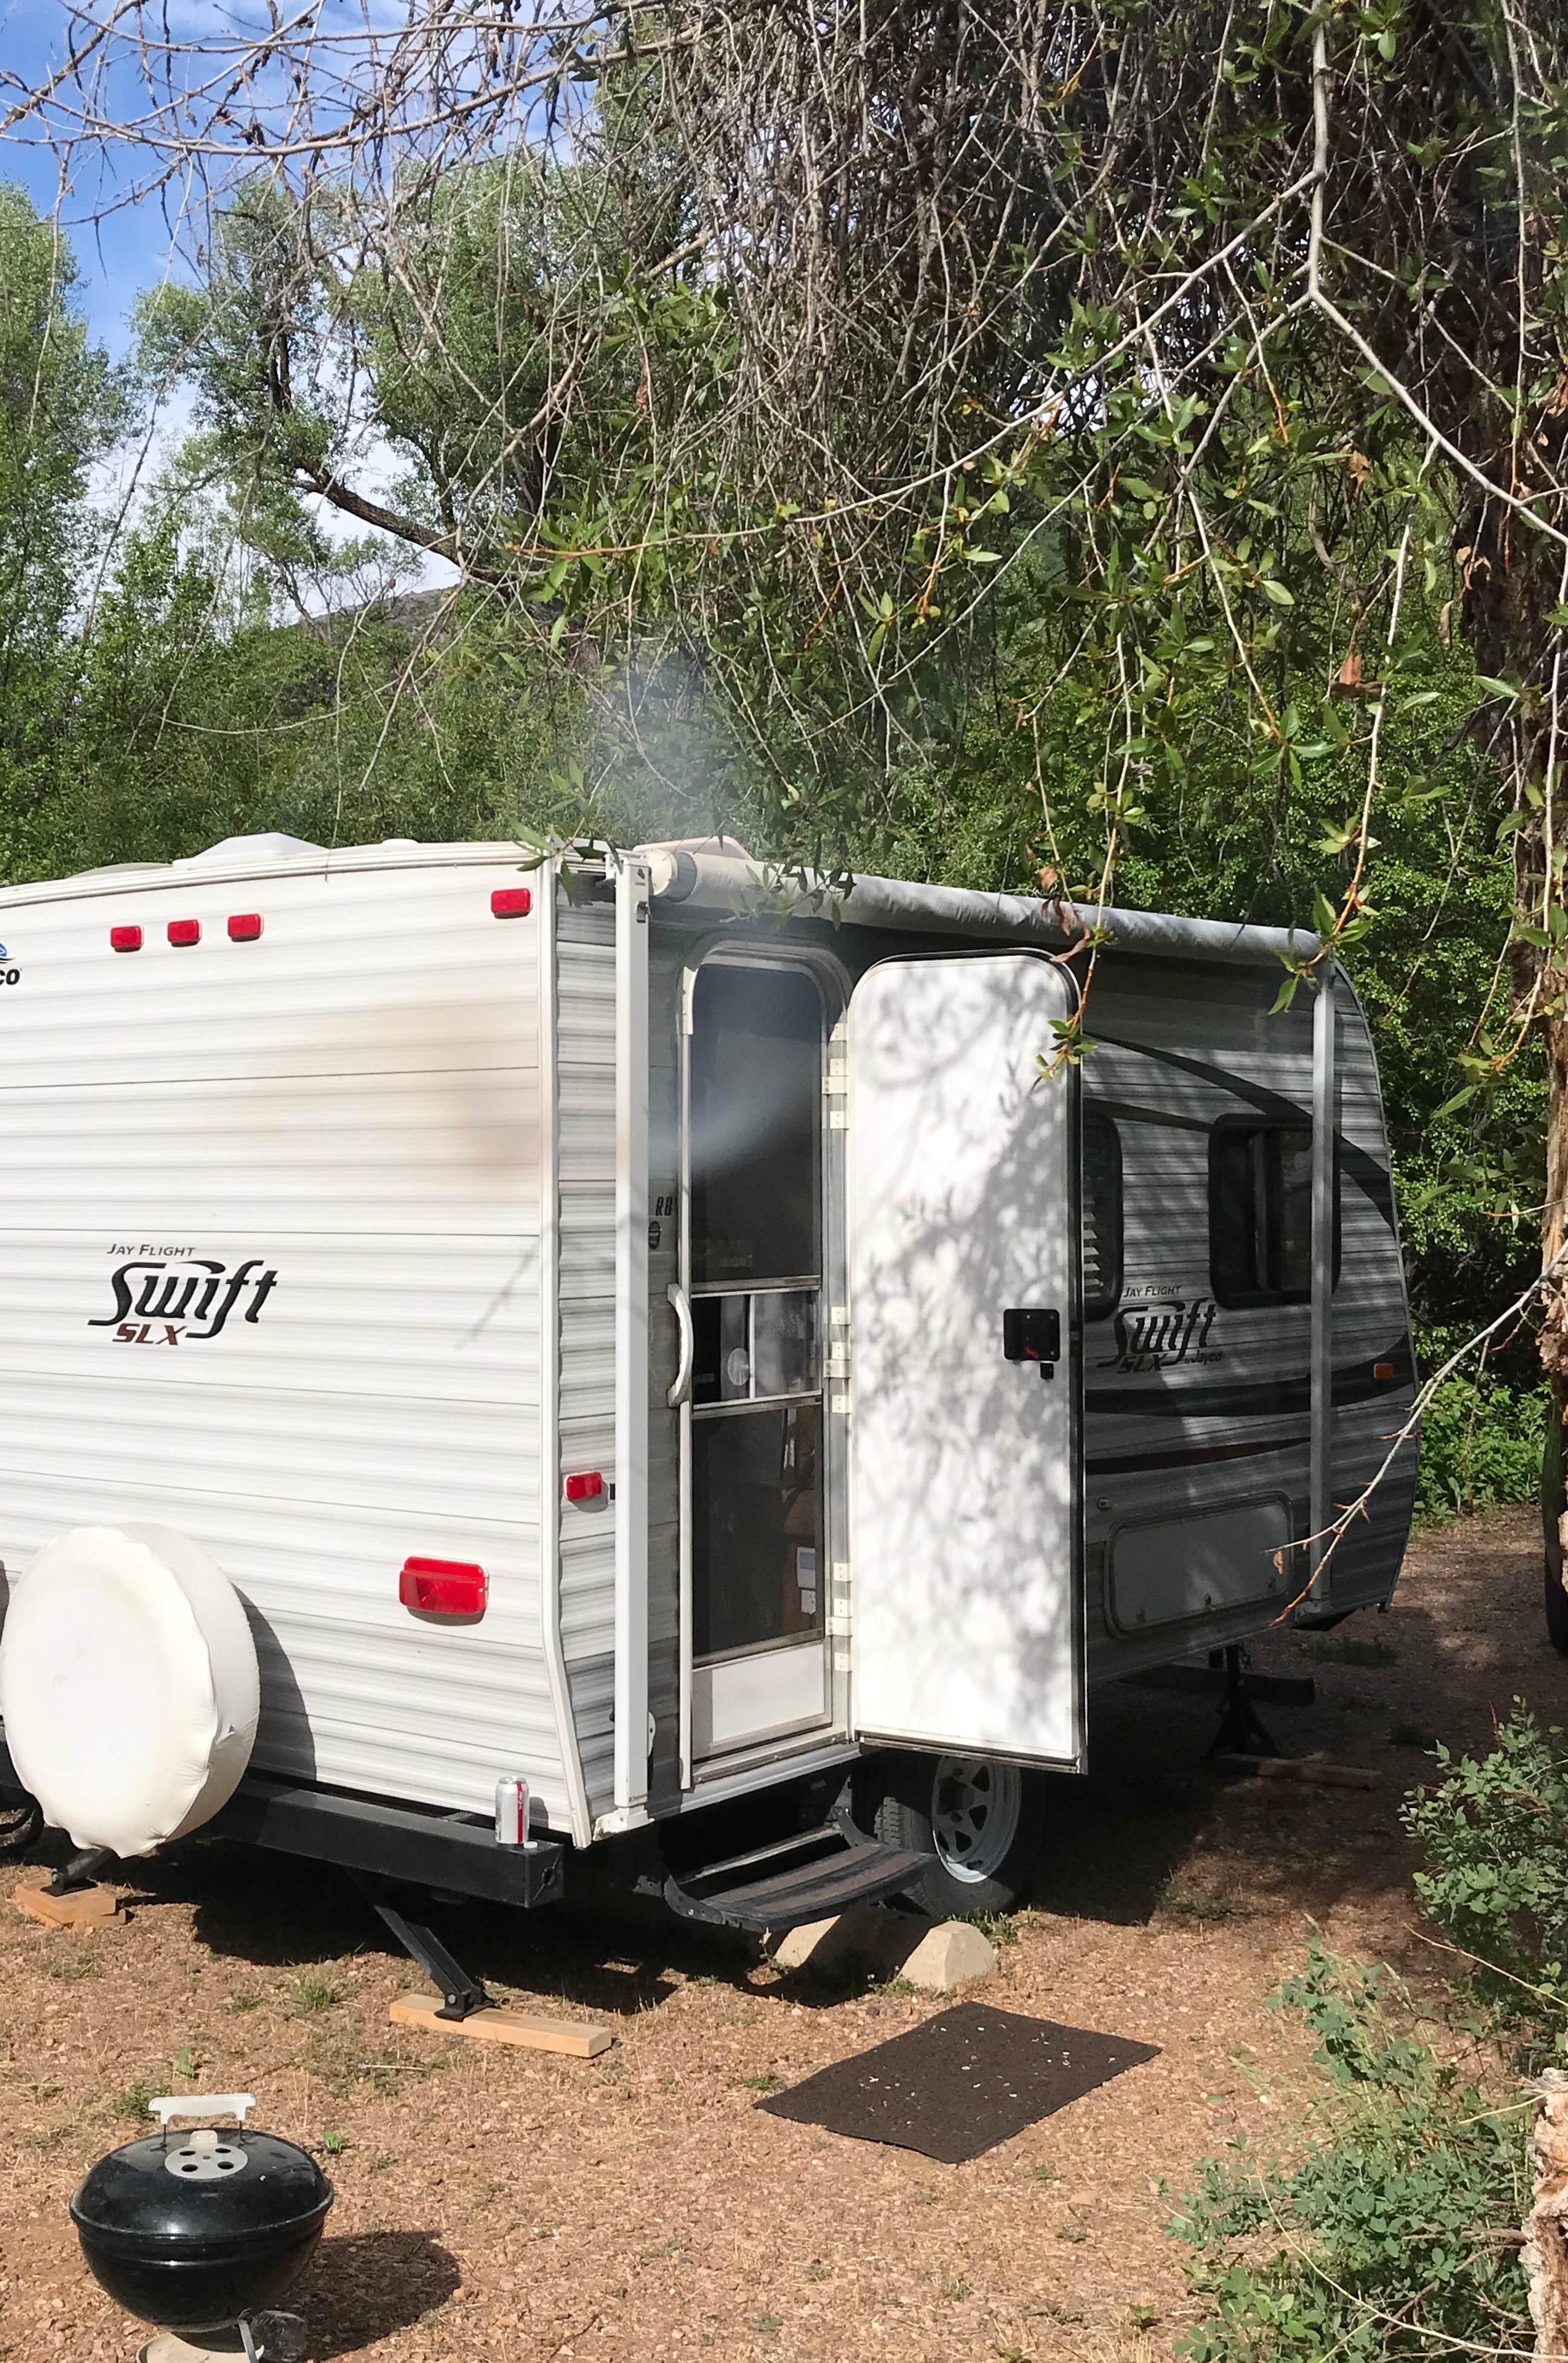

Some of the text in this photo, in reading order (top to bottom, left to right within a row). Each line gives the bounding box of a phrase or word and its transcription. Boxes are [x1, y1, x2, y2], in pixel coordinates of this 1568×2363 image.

[106, 1243, 196, 1257] JAY FLIGHT
[87, 1260, 278, 1339] Swift
[1123, 1286, 1181, 1298] JAY FLIGHT
[112, 1322, 188, 1345] SLX
[1097, 1297, 1217, 1368] Swift
[1117, 1353, 1168, 1374] SLX
